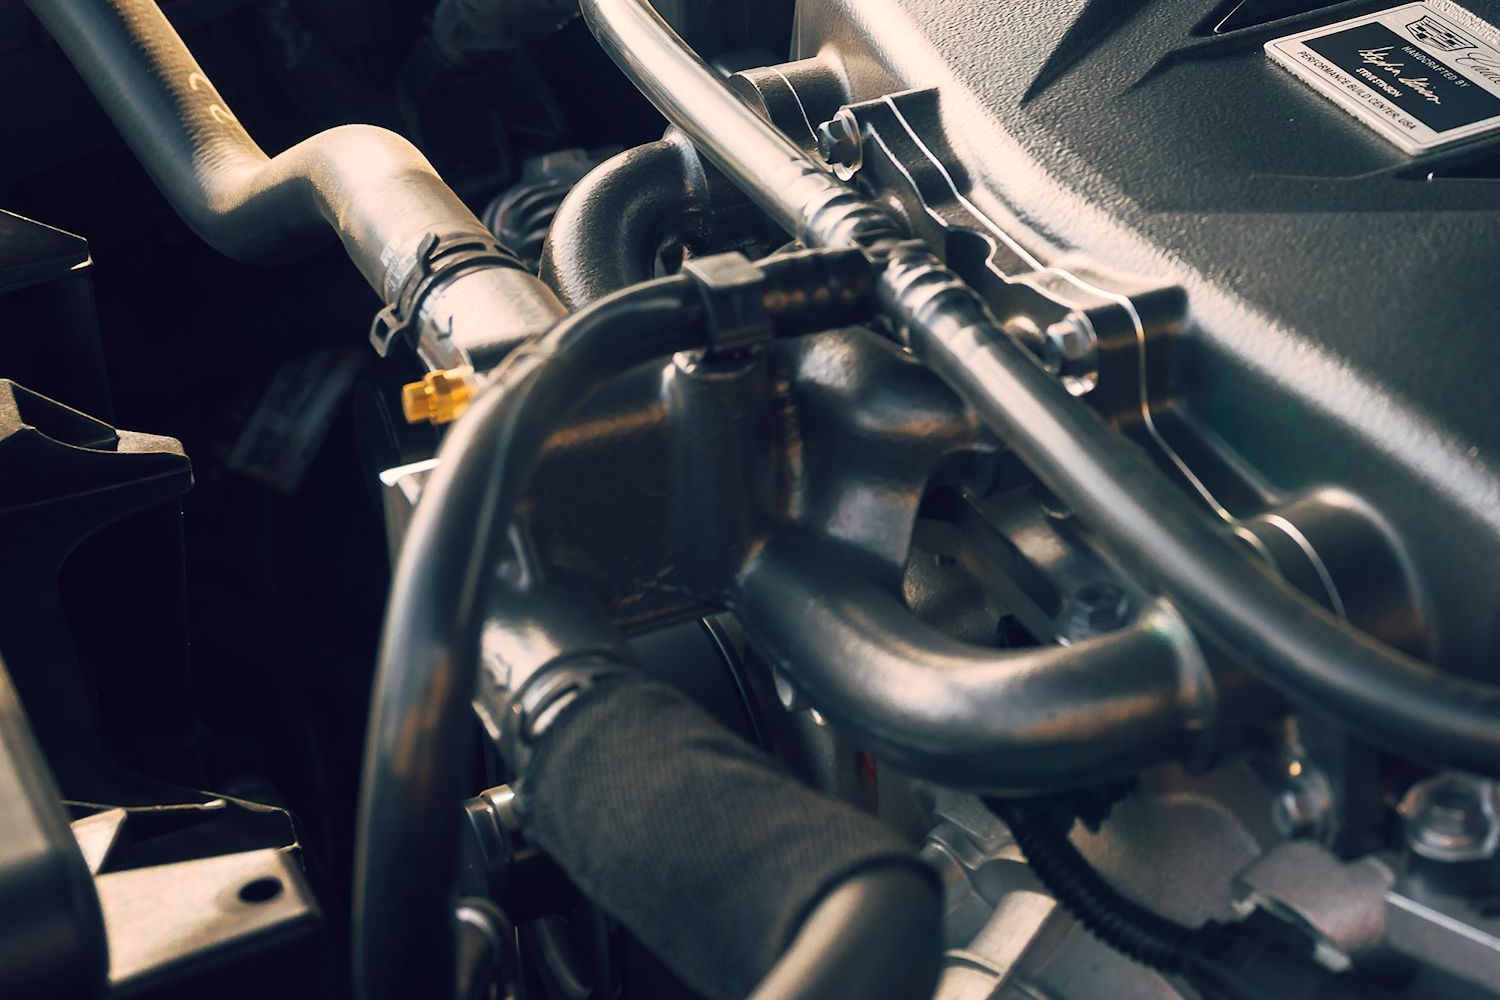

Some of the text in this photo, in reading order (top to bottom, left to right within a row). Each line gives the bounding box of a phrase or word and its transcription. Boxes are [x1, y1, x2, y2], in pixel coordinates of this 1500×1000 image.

[1297, 50, 1352, 85] PERFORMANCE
[1346, 81, 1372, 100] BUILD
[1397, 116, 1418, 131] USA
[1401, 45, 1471, 89] HANDCRAFTED BY
